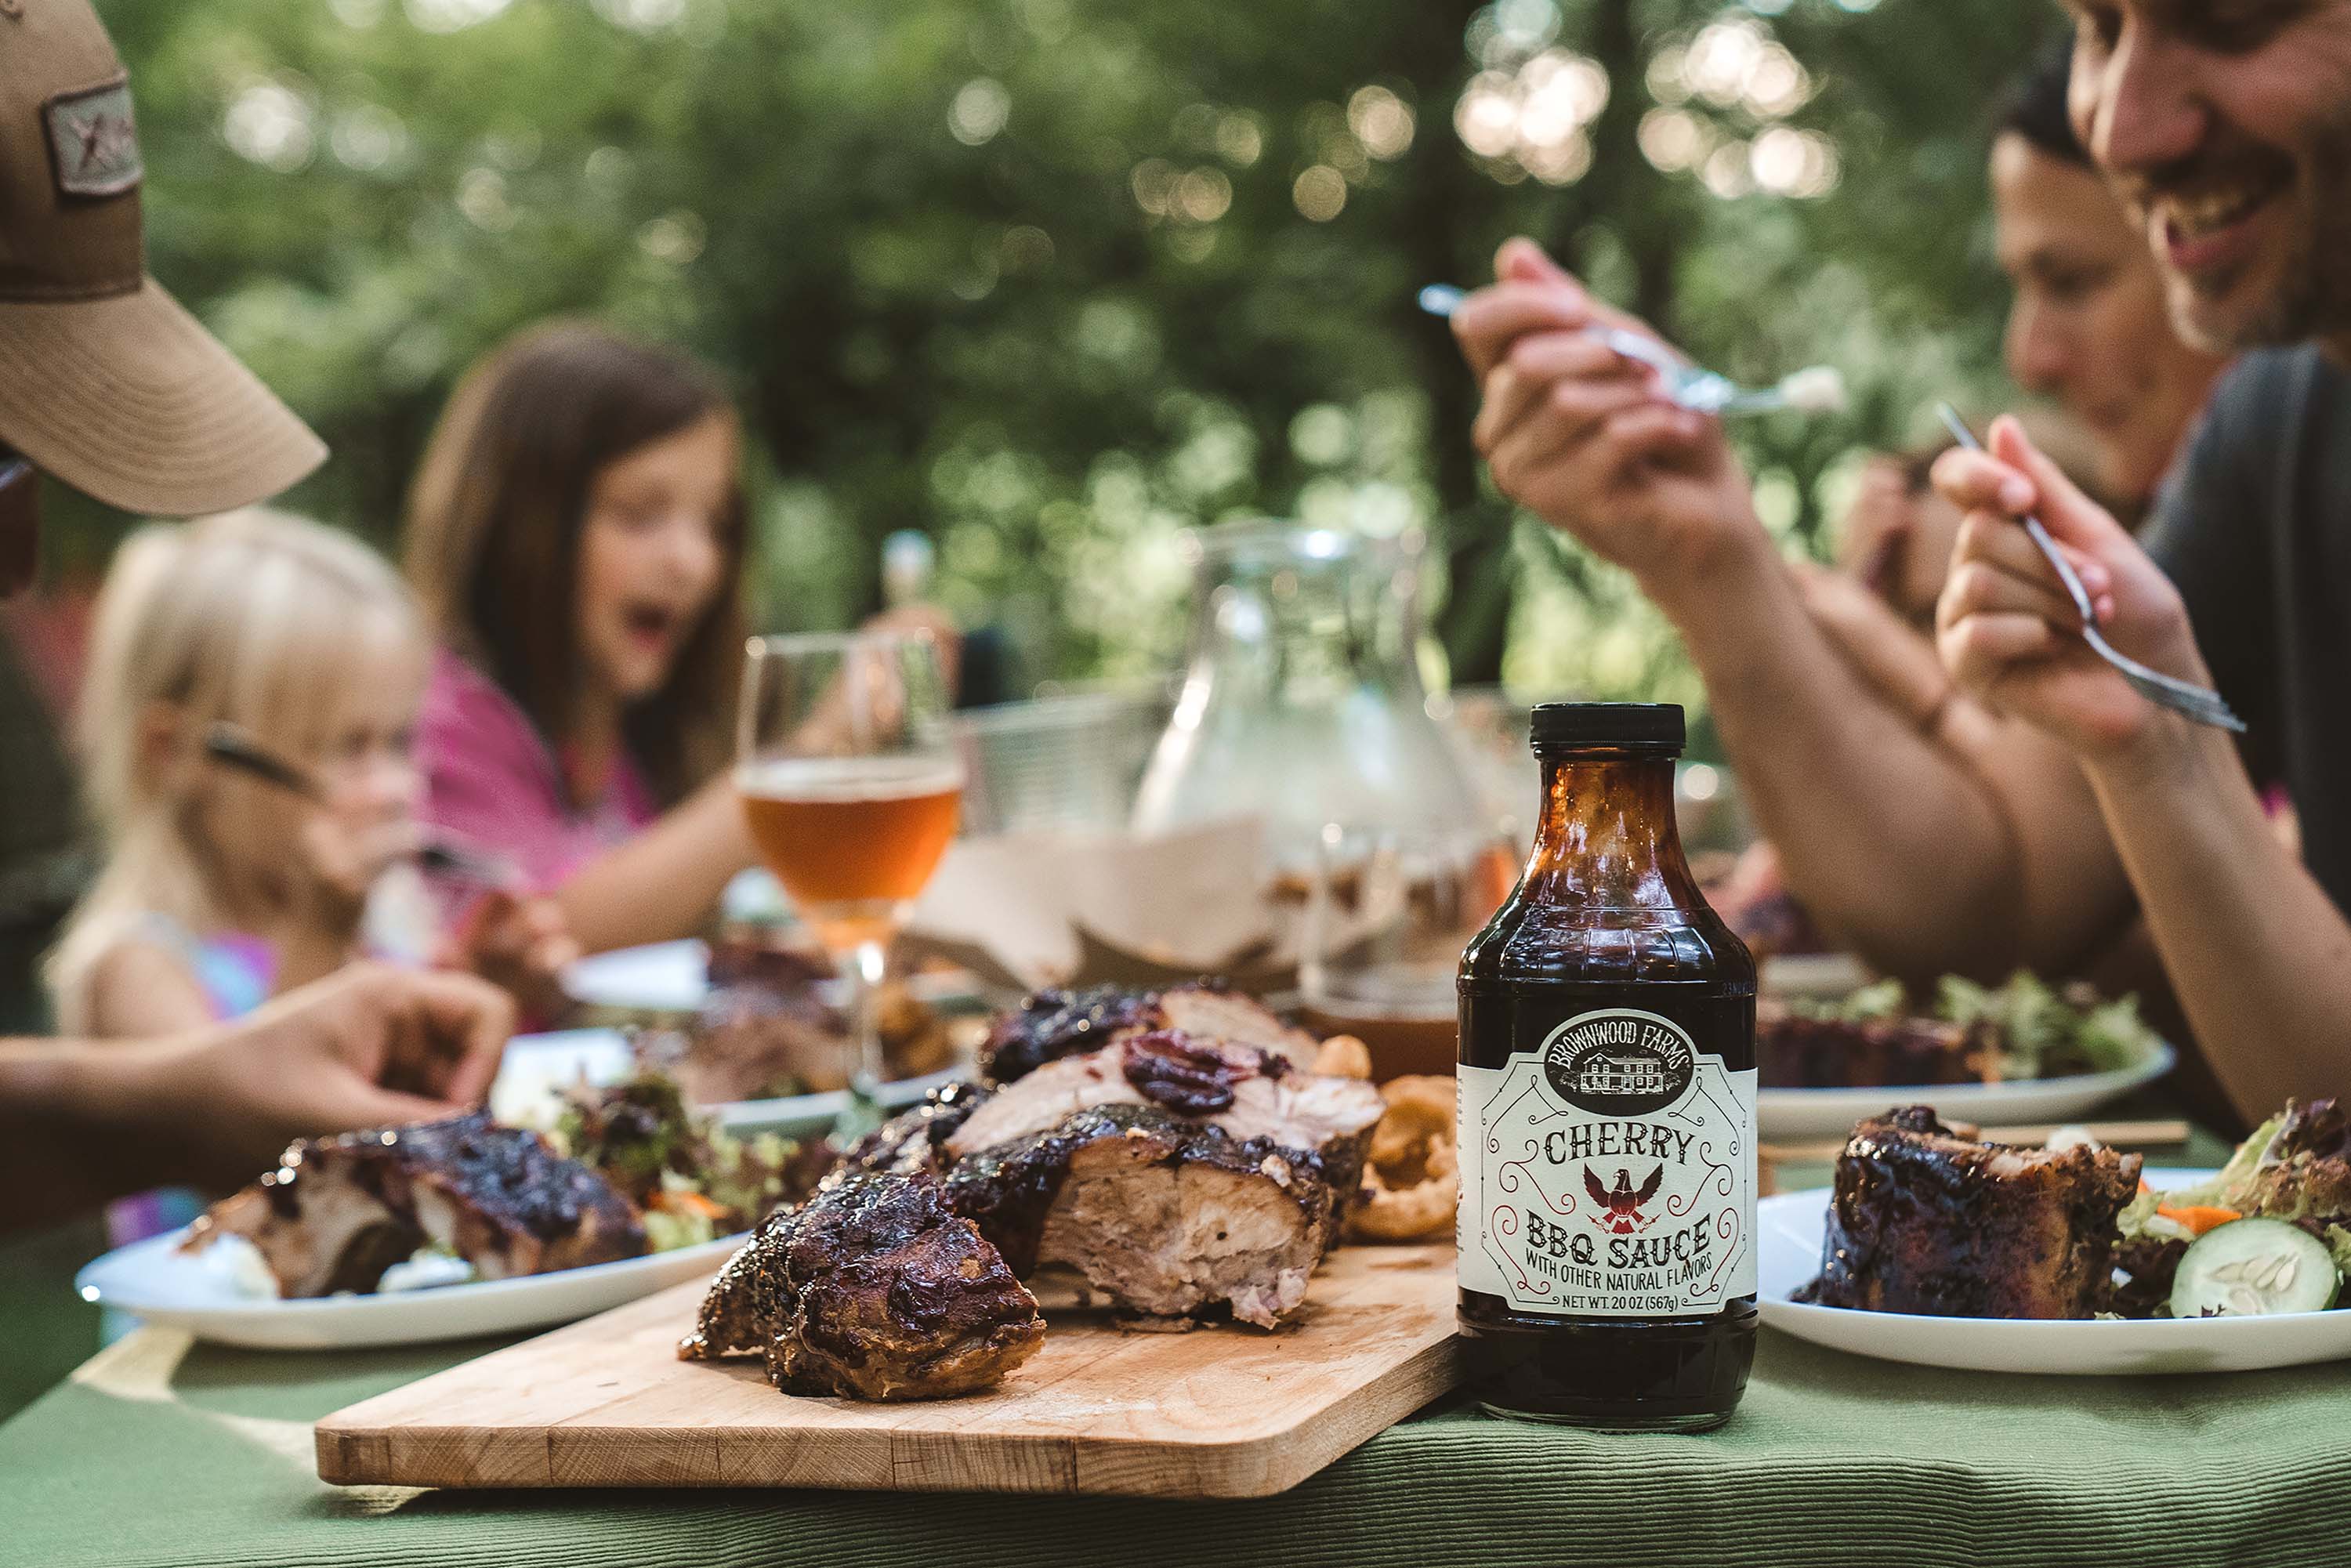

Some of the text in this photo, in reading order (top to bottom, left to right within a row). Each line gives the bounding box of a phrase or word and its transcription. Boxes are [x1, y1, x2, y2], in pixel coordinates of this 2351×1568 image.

[1548, 1021, 1690, 1070] BROWNWOOD FARMS
[1543, 1122, 1696, 1165] CHERRY
[1525, 1209, 1711, 1269] BBQ SAUCE
[1526, 1247, 1712, 1291] WITH OTHER NATURAL FLAVORS
[1562, 1295, 1679, 1313] NET WT. 20 OZ (567g)
